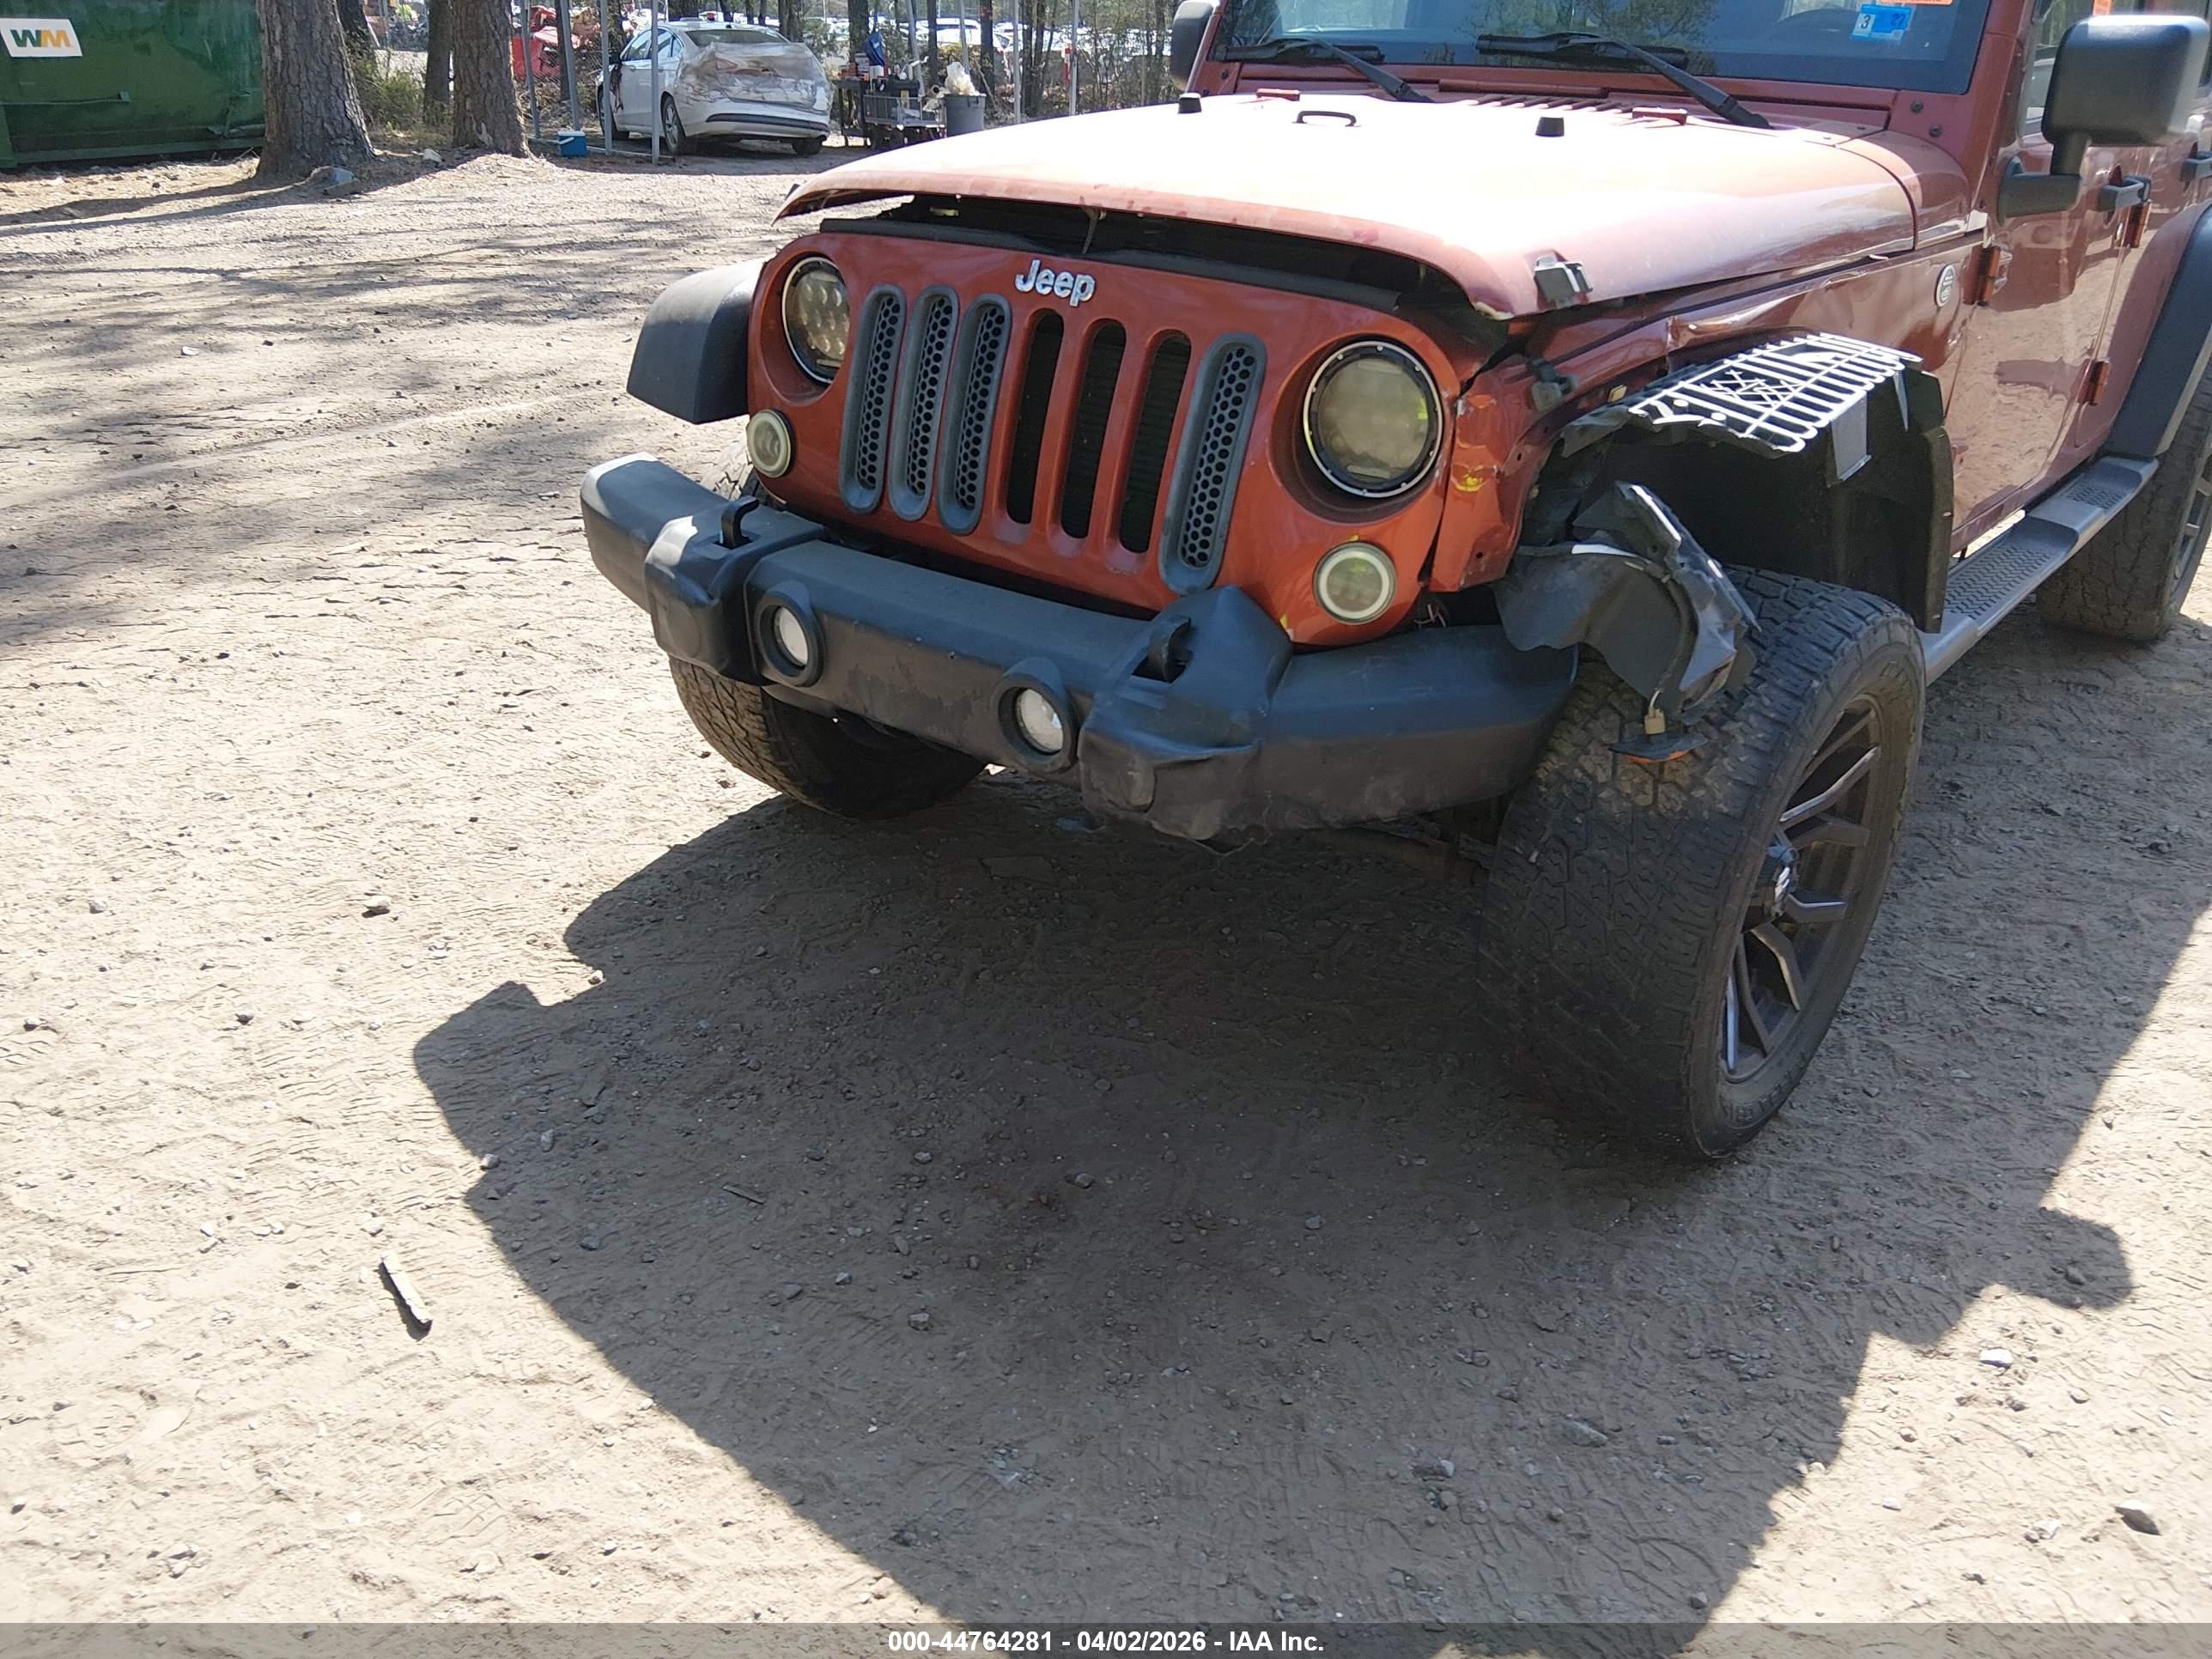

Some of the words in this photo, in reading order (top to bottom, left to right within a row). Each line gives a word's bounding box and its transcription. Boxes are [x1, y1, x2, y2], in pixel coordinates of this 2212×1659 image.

[1860, 14, 1871, 29] 3
[1891, 13, 1906, 27] 27
[9, 28, 71, 48] WM
[1015, 259, 1096, 307] Jeep
